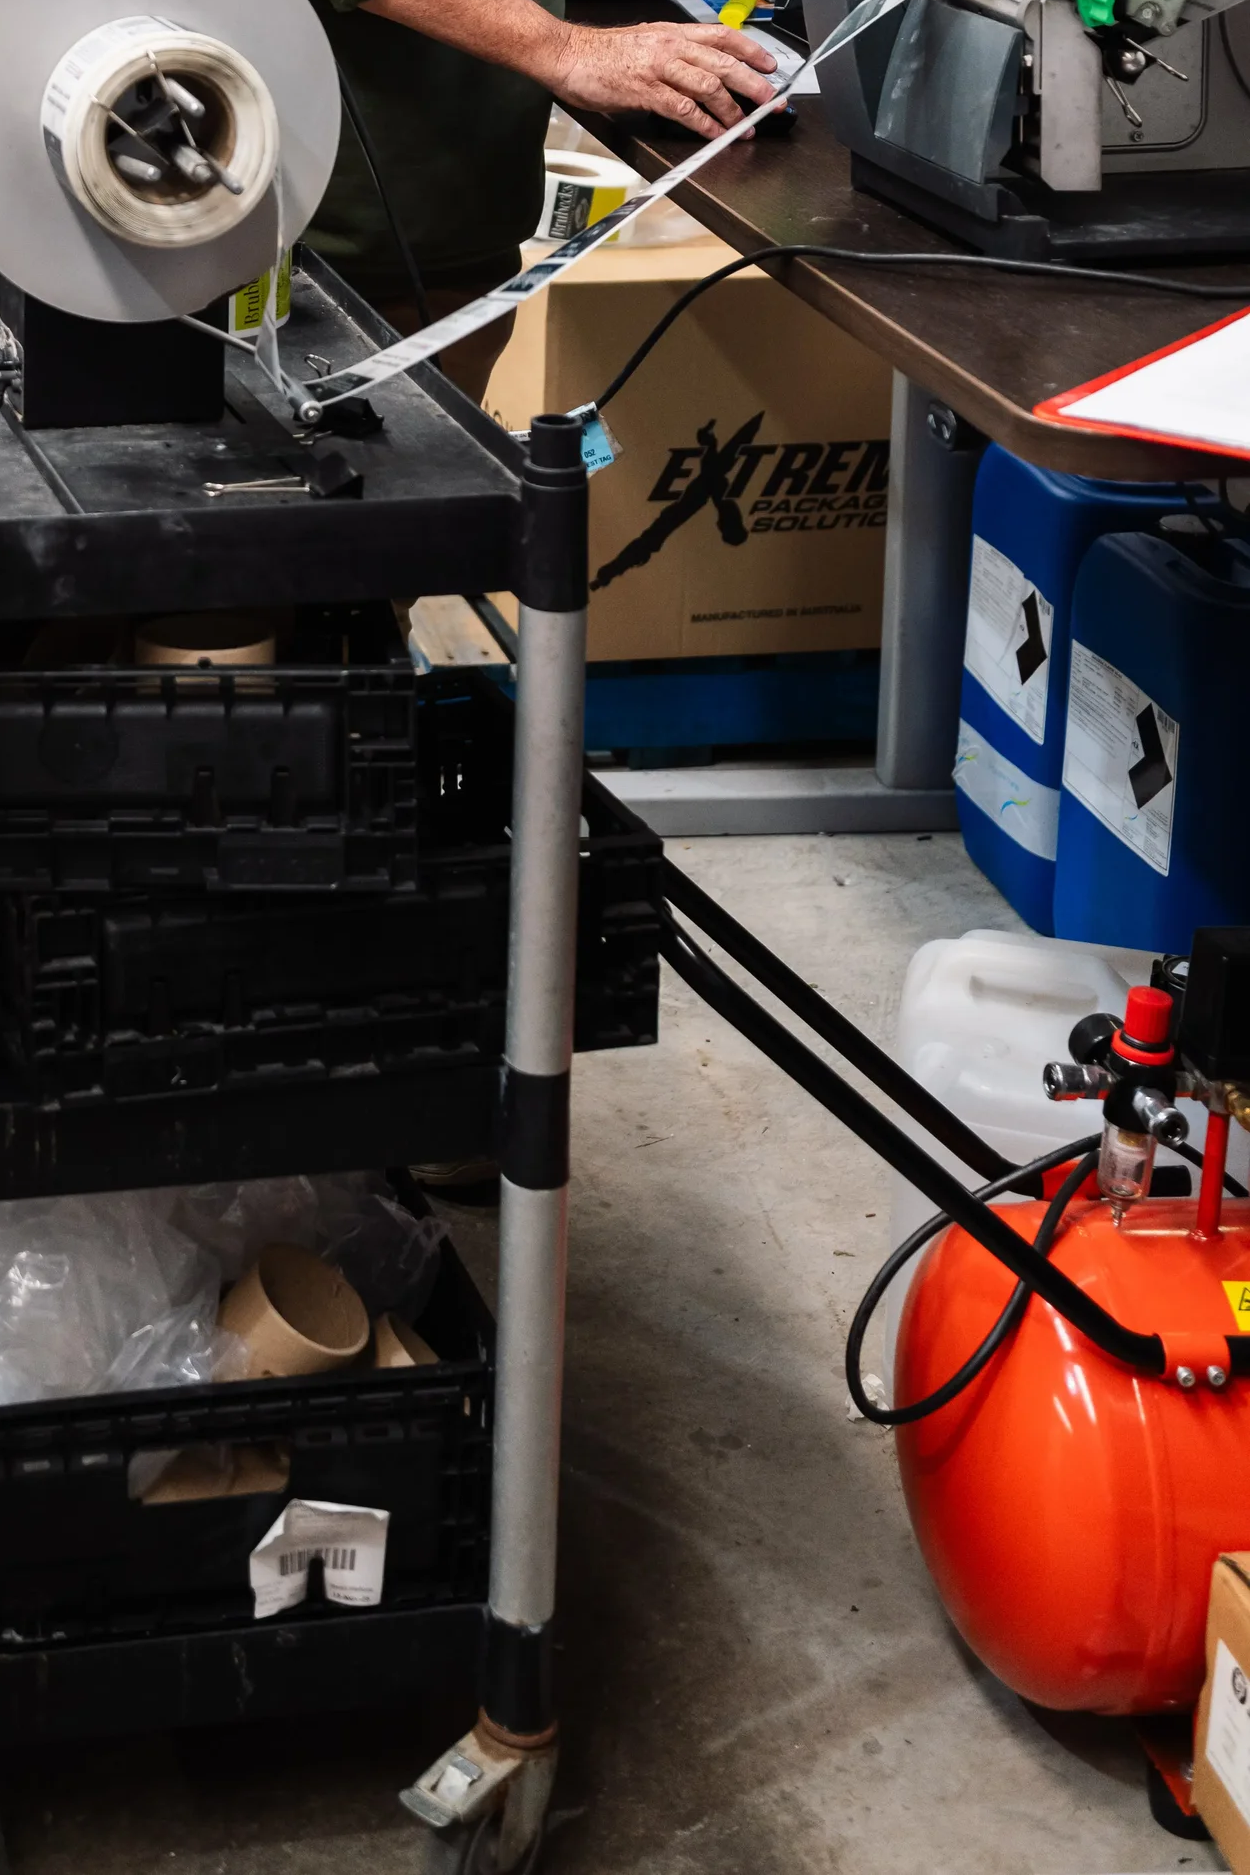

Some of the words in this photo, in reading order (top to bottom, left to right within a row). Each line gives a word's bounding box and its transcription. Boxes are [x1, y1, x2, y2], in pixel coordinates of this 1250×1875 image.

[584, 449, 596, 459] 052
[586, 458, 598, 468] EST
[599, 454, 612, 463] TAG
[749, 494, 888, 516] PACKAG
[750, 512, 887, 533] SOLUTIO
[691, 608, 784, 623] MANUFACTURED
[786, 607, 798, 617] IN
[800, 604, 862, 615] AUSTRALIA
